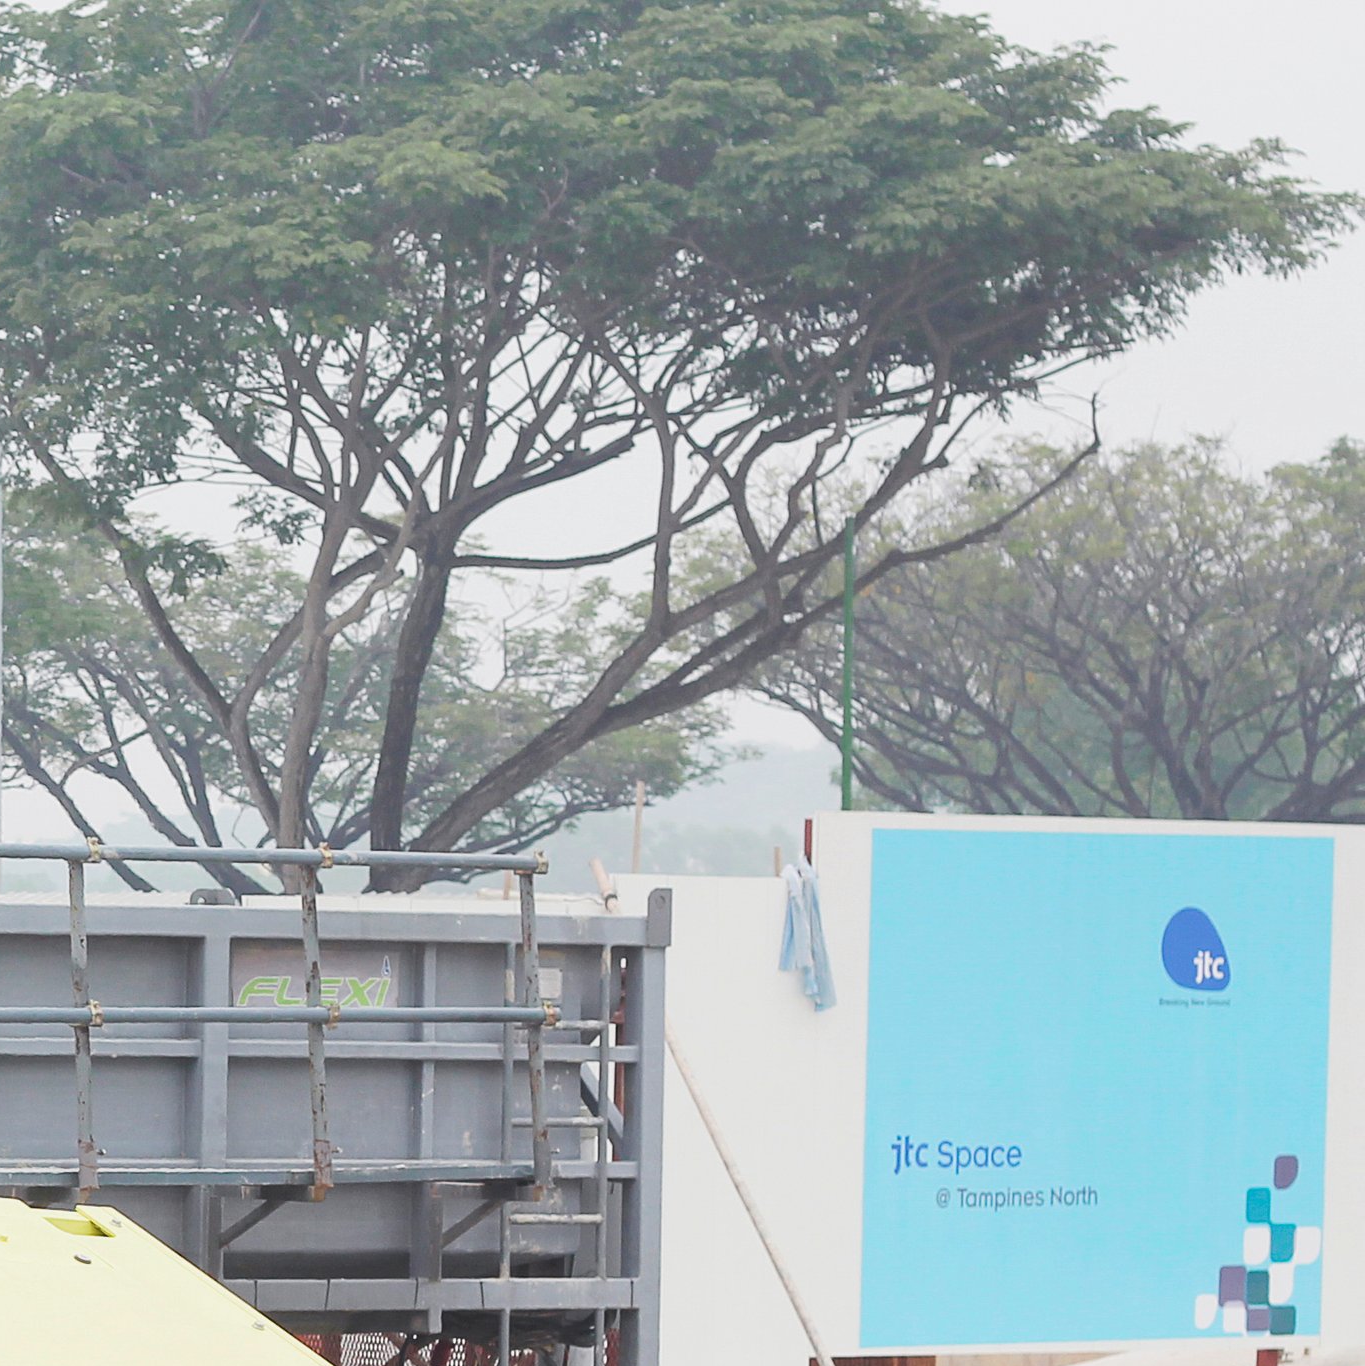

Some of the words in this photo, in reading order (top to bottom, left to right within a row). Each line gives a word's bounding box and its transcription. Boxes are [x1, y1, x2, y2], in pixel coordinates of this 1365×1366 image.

[1193, 950, 1225, 984] jtc
[891, 1135, 929, 1175] jtc
[937, 1141, 1022, 1175] Space
[936, 1188, 951, 1209] @
[957, 1187, 1045, 1212] Tampines
[1049, 1185, 1099, 1206] North
